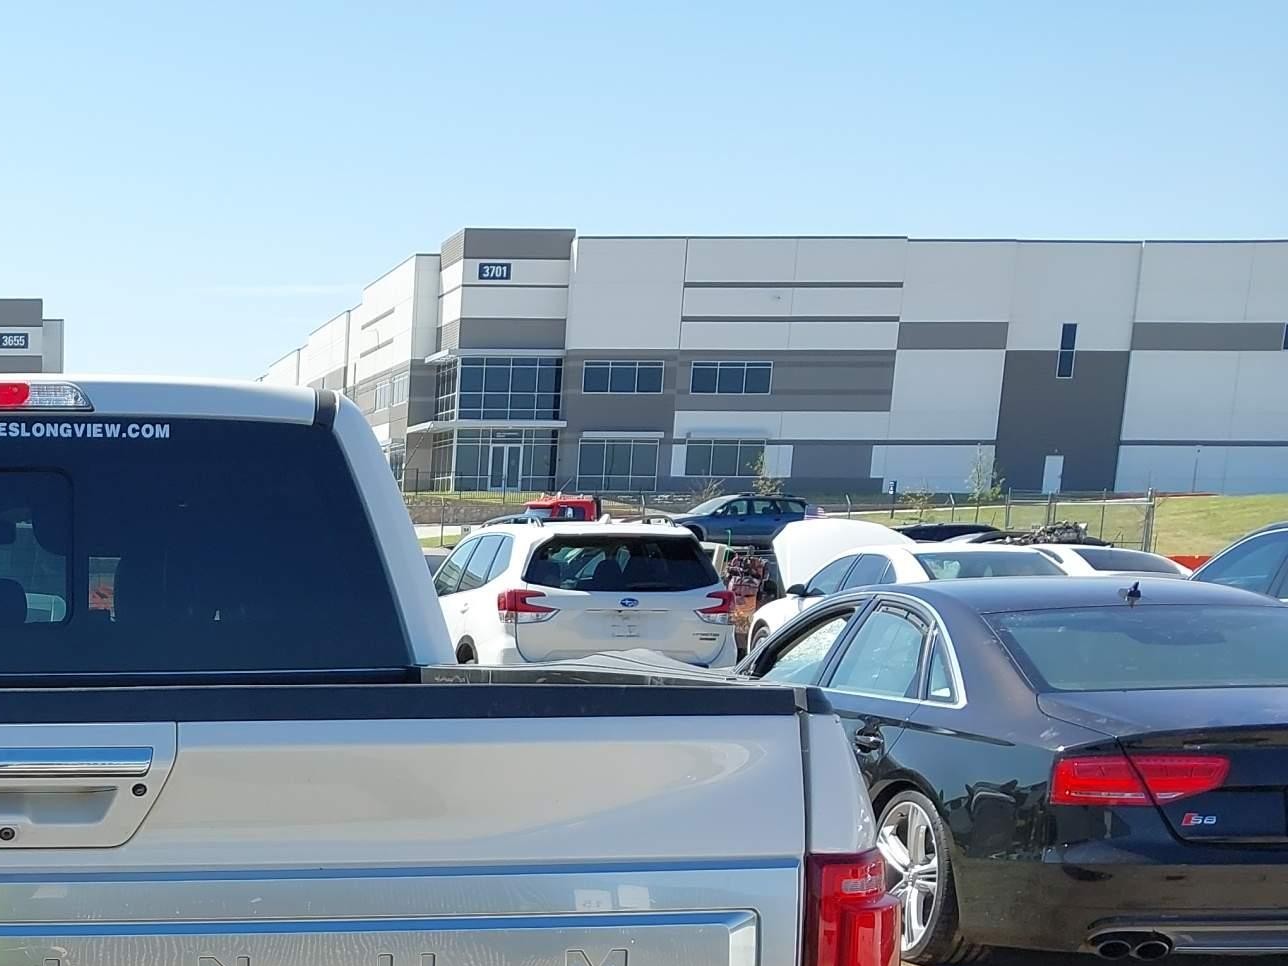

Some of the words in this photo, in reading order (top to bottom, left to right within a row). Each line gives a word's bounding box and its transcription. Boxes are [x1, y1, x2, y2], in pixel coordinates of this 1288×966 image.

[482, 265, 508, 278] 3701
[2, 335, 25, 346] 3655
[1188, 814, 1217, 825] S8
